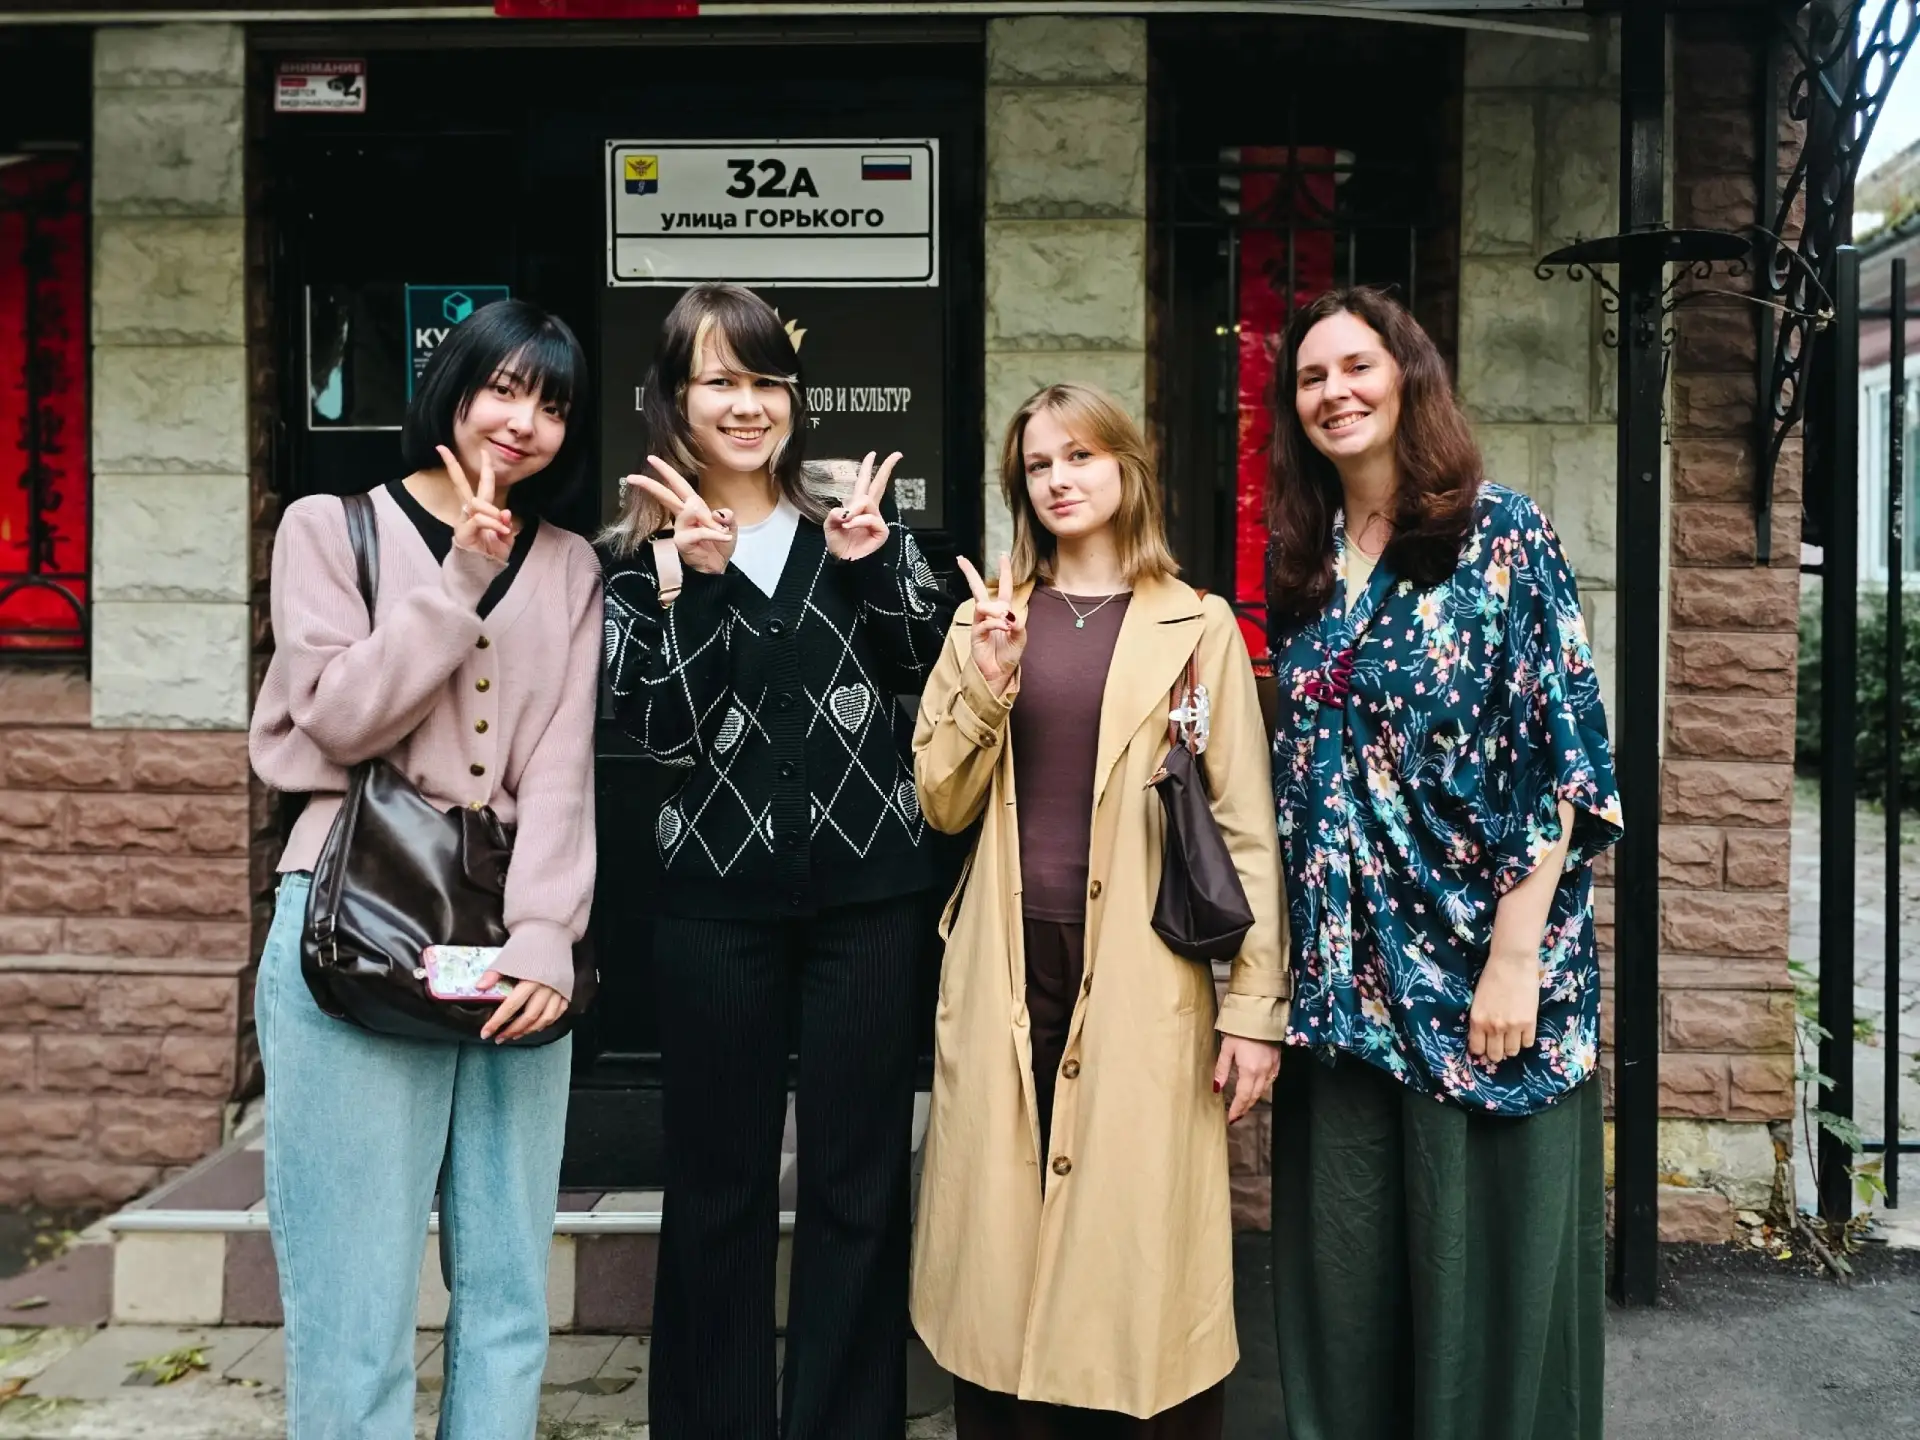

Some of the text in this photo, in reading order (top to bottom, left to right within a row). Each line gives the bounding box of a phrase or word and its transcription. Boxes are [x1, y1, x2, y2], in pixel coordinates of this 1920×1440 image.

[280, 62, 361, 74] ВНИМАНИЕ
[725, 158, 820, 199] 32А
[661, 208, 885, 231] улица ГОРЬКОГО
[805, 387, 912, 412] КОВ И КУЛЬТУР
